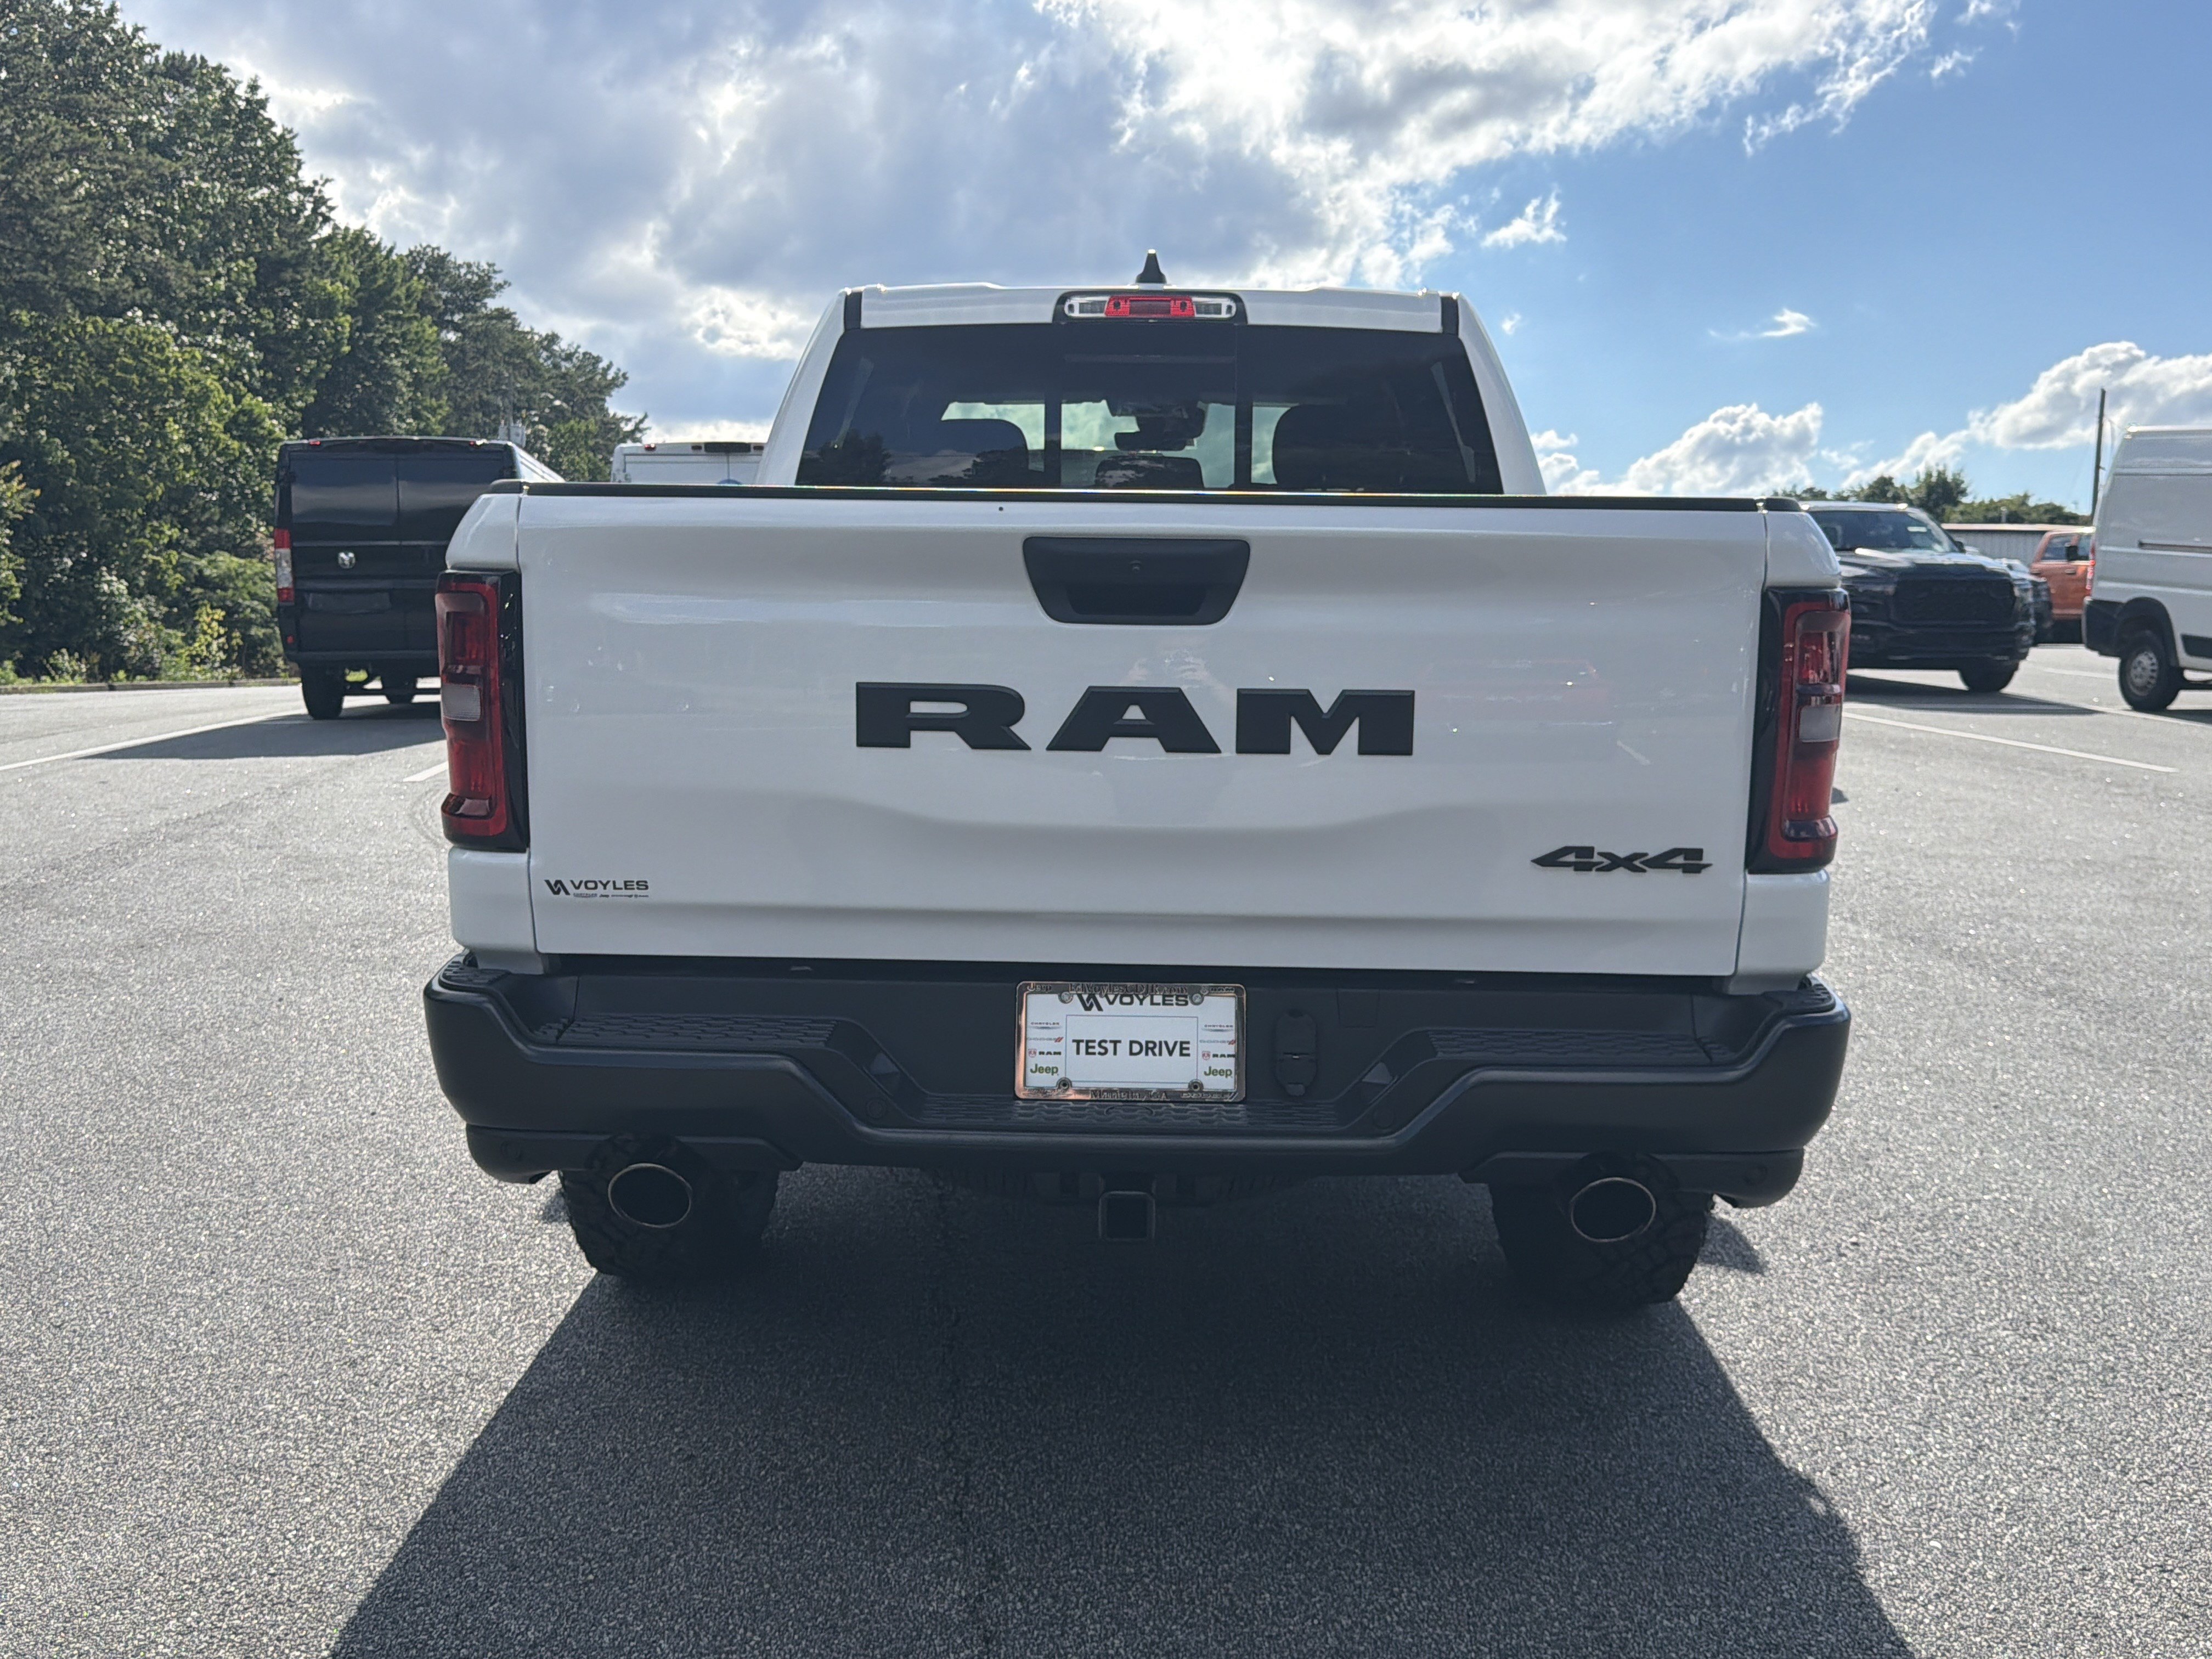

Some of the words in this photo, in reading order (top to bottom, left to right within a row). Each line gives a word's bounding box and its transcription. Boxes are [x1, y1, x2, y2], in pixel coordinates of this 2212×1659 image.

[856, 681, 1415, 756] RAM
[1531, 845, 1713, 874] 4x4
[570, 879, 649, 890] VOYLES
[1104, 994, 1189, 1007] VOYLES
[1071, 1039, 1122, 1056] TEST
[1128, 1040, 1191, 1057] DRIVE
[1030, 1063, 1059, 1076] Jeep
[1204, 1066, 1233, 1079] Jeep
